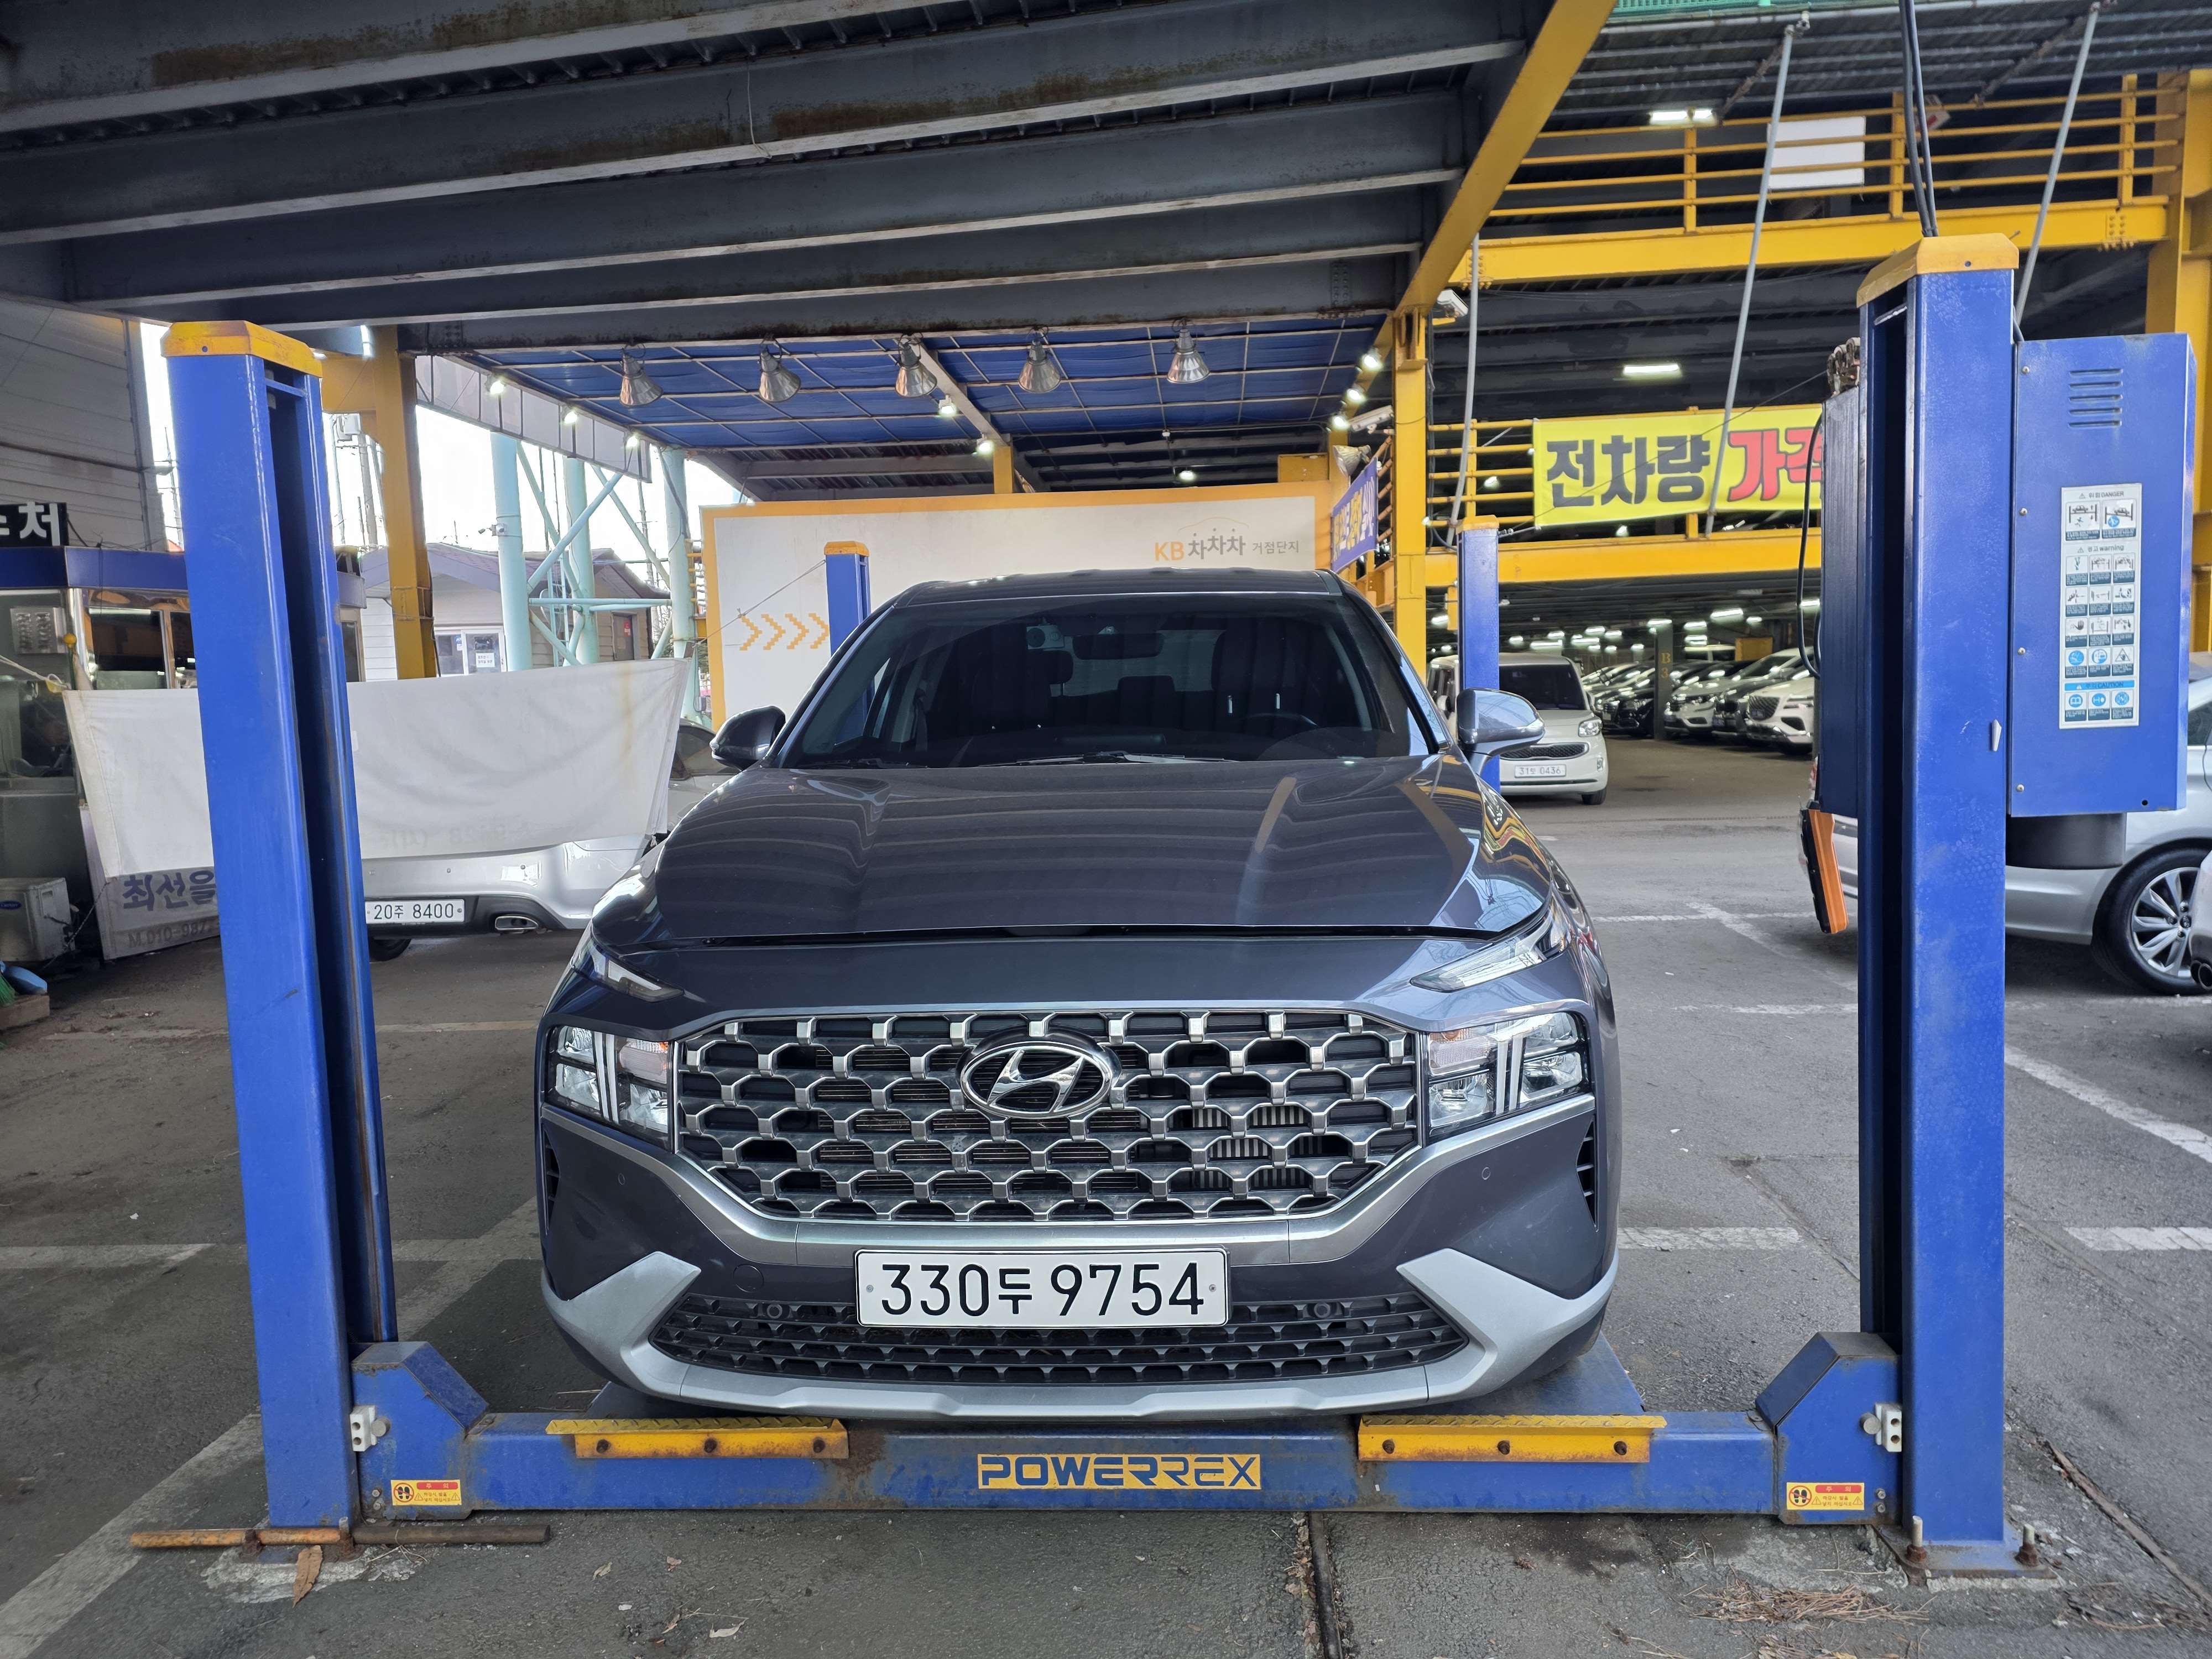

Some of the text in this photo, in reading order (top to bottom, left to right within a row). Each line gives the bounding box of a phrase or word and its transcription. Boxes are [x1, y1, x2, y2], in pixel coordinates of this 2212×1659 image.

[1547, 435, 1710, 508] 전차량
[0, 500, 60, 546] 처
[1155, 528, 1299, 561] KB 차차차 거점단지
[1661, 653, 1671, 663] B
[1661, 667, 1668, 678] 3
[122, 870, 216, 911] 최선을
[374, 903, 453, 919] 20주 8400
[881, 1262, 1204, 1317] 330두 9754
[982, 1457, 1256, 1486] POWERREX
